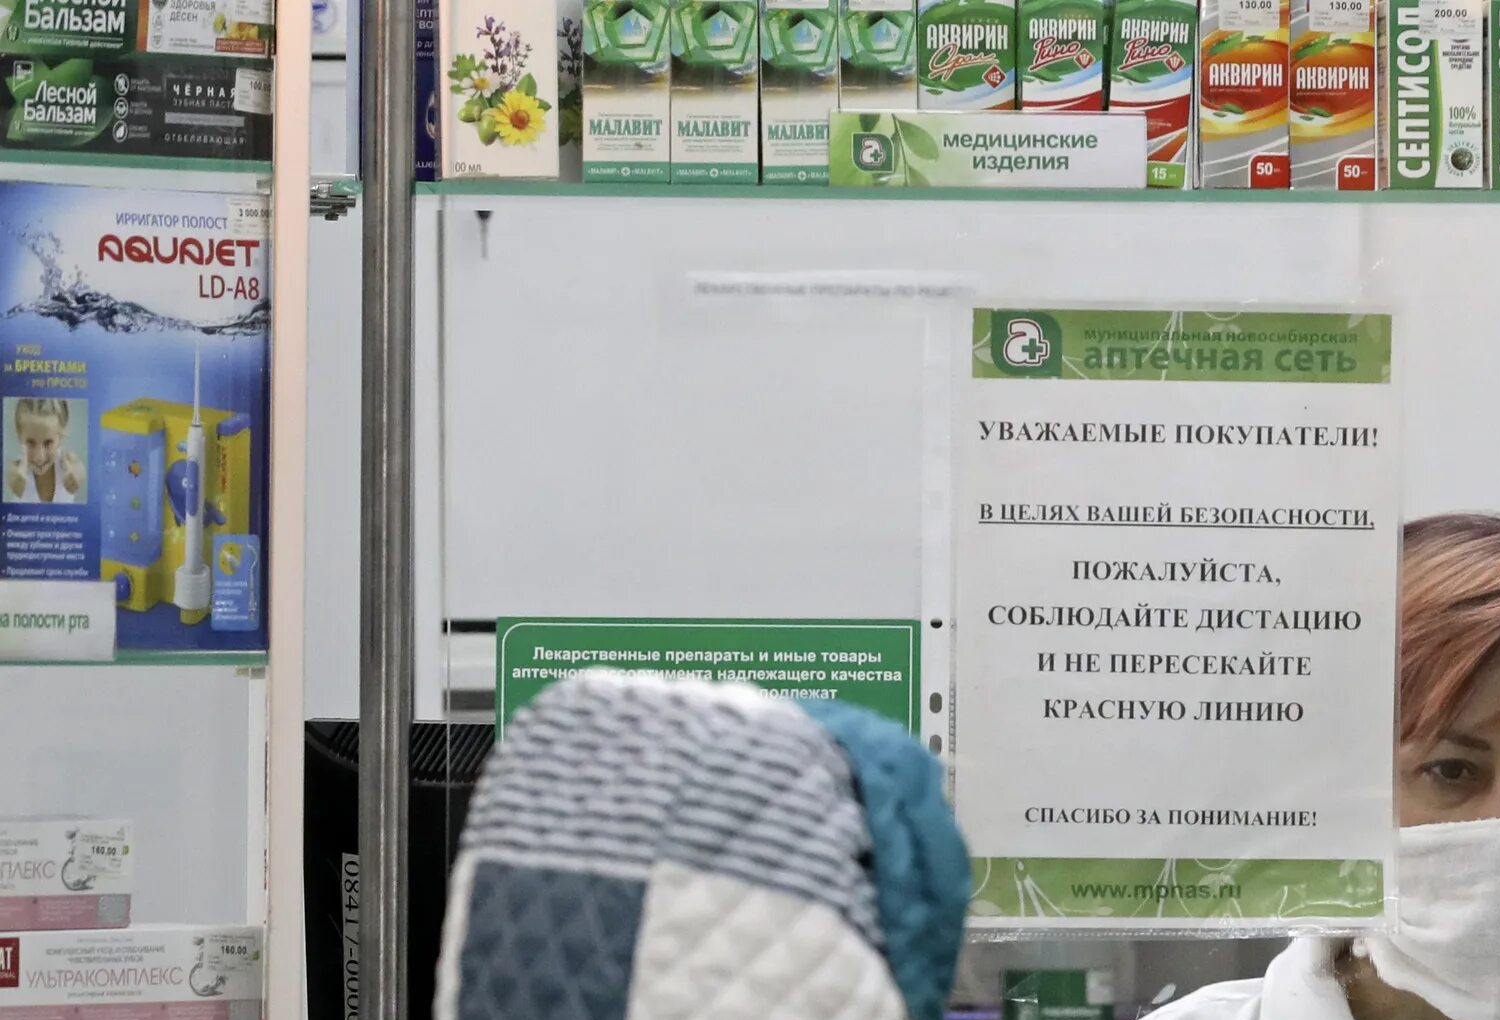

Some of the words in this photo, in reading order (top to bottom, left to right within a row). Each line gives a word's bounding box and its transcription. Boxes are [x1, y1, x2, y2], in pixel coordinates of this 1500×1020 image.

[25, 7, 125, 35] Бальзам
[1029, 18, 1097, 41] АКВИРИН
[1121, 18, 1189, 43] АКВИРИН
[926, 24, 1008, 50] АКВИРИН
[1209, 63, 1283, 88] АКВИРИН
[1296, 66, 1369, 91] АКВИРИН
[34, 80, 97, 105] Лесной
[172, 82, 236, 98] ЧЁРНАЯ
[24, 99, 96, 124] Бальзам
[1449, 106, 1477, 121] 100%
[589, 119, 662, 136] МАЛАВИТ
[678, 120, 751, 137] МАЛАВИТ
[943, 132, 1098, 150] медицинские
[972, 154, 1069, 172] изделия
[1152, 168, 1167, 180] 15
[1256, 162, 1273, 175] 50
[1344, 165, 1360, 178] 50
[115, 212, 179, 228] ИРРИГАТОР
[182, 215, 228, 229] ПОЛОСТ
[98, 234, 260, 267] AQUAJET
[199, 275, 260, 300] LD-A8
[1084, 327, 1222, 345] муниципальная
[1225, 329, 1358, 346] новосибирская
[1084, 346, 1264, 372] аптечная
[1274, 347, 1358, 373] сеть
[978, 421, 1167, 444] УВАЖАЕМЫЕ
[1175, 424, 1379, 447] ПОКУПАТЕЛИ!
[979, 504, 994, 521] В
[1000, 504, 1080, 524] ЦЕЛЯХ
[1087, 499, 1172, 524] ВАШЕЙ
[1180, 507, 1375, 528] БЕЗОПАСНОСТИ,
[1072, 558, 1281, 586] ПОЖАЛУЙСТА,
[13, 614, 66, 629] полости
[69, 615, 89, 634] рта
[988, 603, 1189, 628] СОБЛЮДАЙТЕ
[1196, 608, 1362, 633] ДИСТАЦИЮ
[532, 647, 661, 663] Лекарственные
[665, 649, 754, 664] препараты
[759, 651, 769, 662] и
[773, 651, 817, 662] иные
[821, 650, 882, 665] товары
[1038, 653, 1055, 672] И
[1065, 653, 1101, 673] НЕ
[1110, 651, 1312, 677] ПЕРЕСЕКАЙТЕ
[717, 667, 826, 682] надлежащего
[830, 670, 902, 681] качества
[1043, 699, 1186, 721] КРАСНУЮ
[1193, 701, 1305, 722] ЛИНИЮ
[1025, 807, 1131, 825] СПАСИБО
[1136, 809, 1161, 825] ЗА
[1168, 808, 1318, 827] ПОНИМАНИЕ!
[1072, 882, 1241, 902] www.mpnas.ru
[26, 967, 184, 989] УЛЬТРАКОМПЛЕКС
